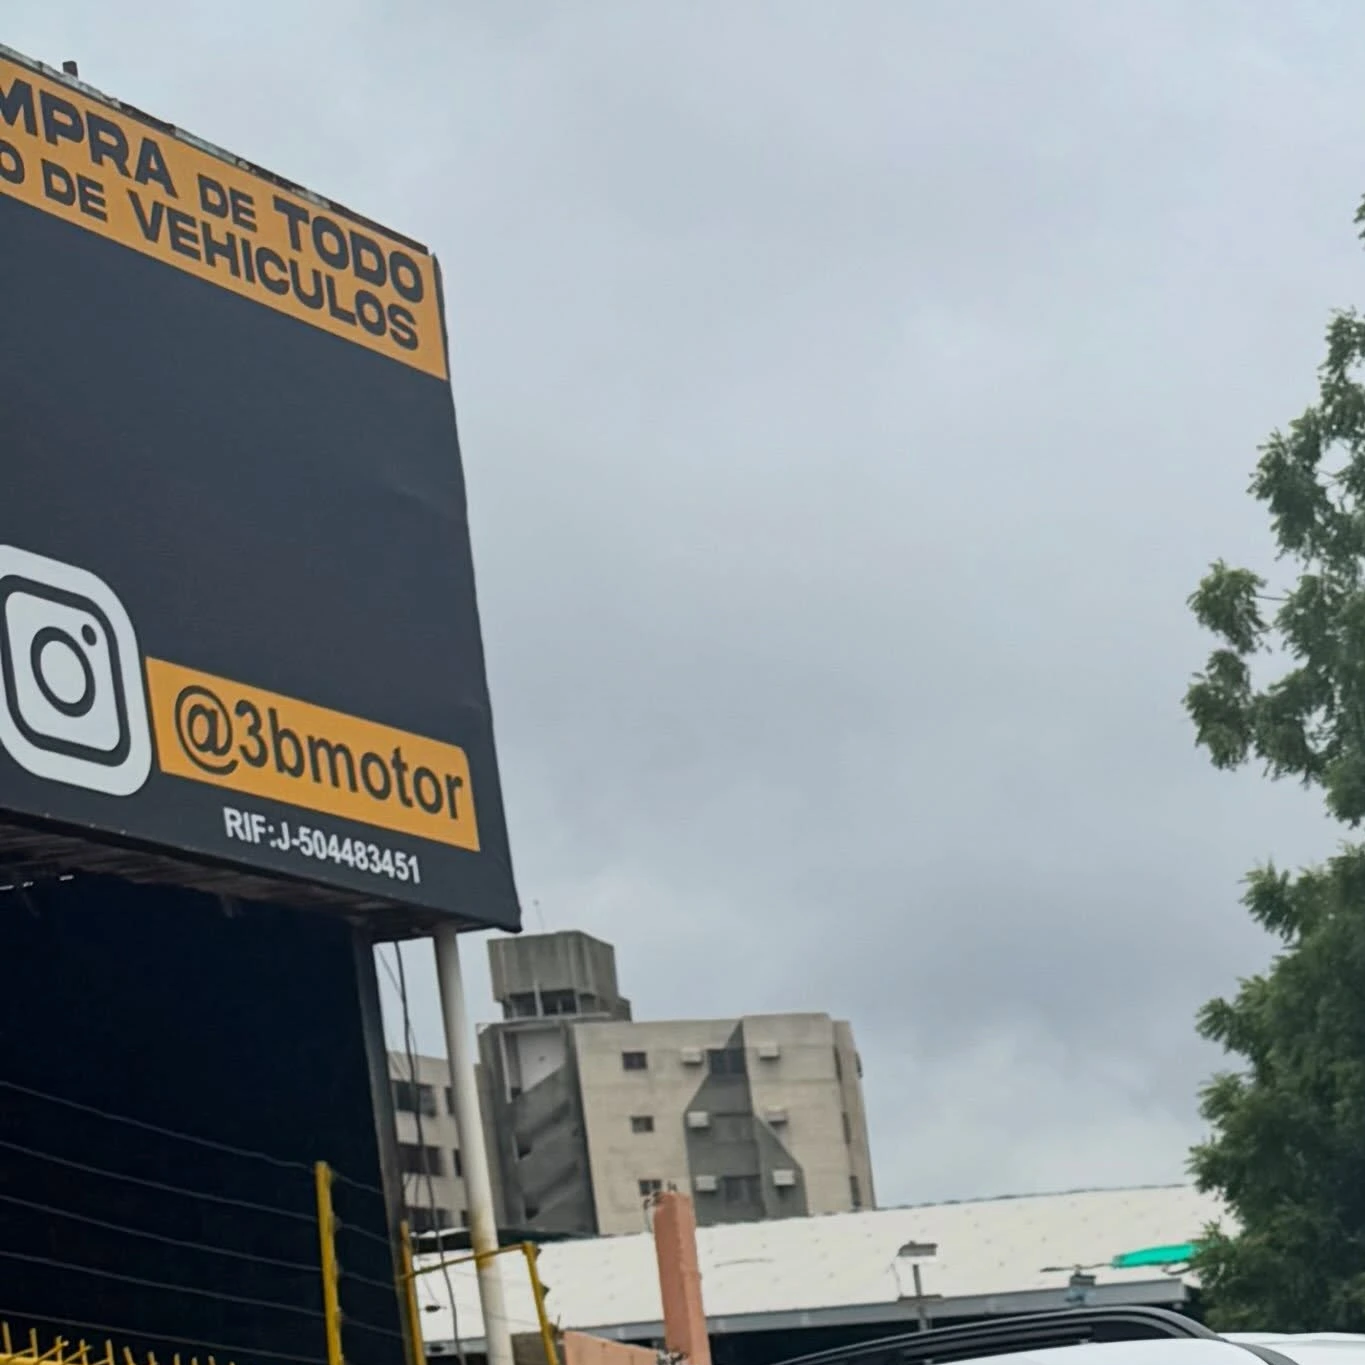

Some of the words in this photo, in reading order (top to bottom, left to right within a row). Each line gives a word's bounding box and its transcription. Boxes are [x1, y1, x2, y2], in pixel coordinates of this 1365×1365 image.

[41, 158, 107, 222] DE
[128, 190, 419, 351] VEHICULOS
[197, 173, 257, 233] DE
[273, 195, 424, 303] TODO
[174, 685, 464, 819] @3bmotor
